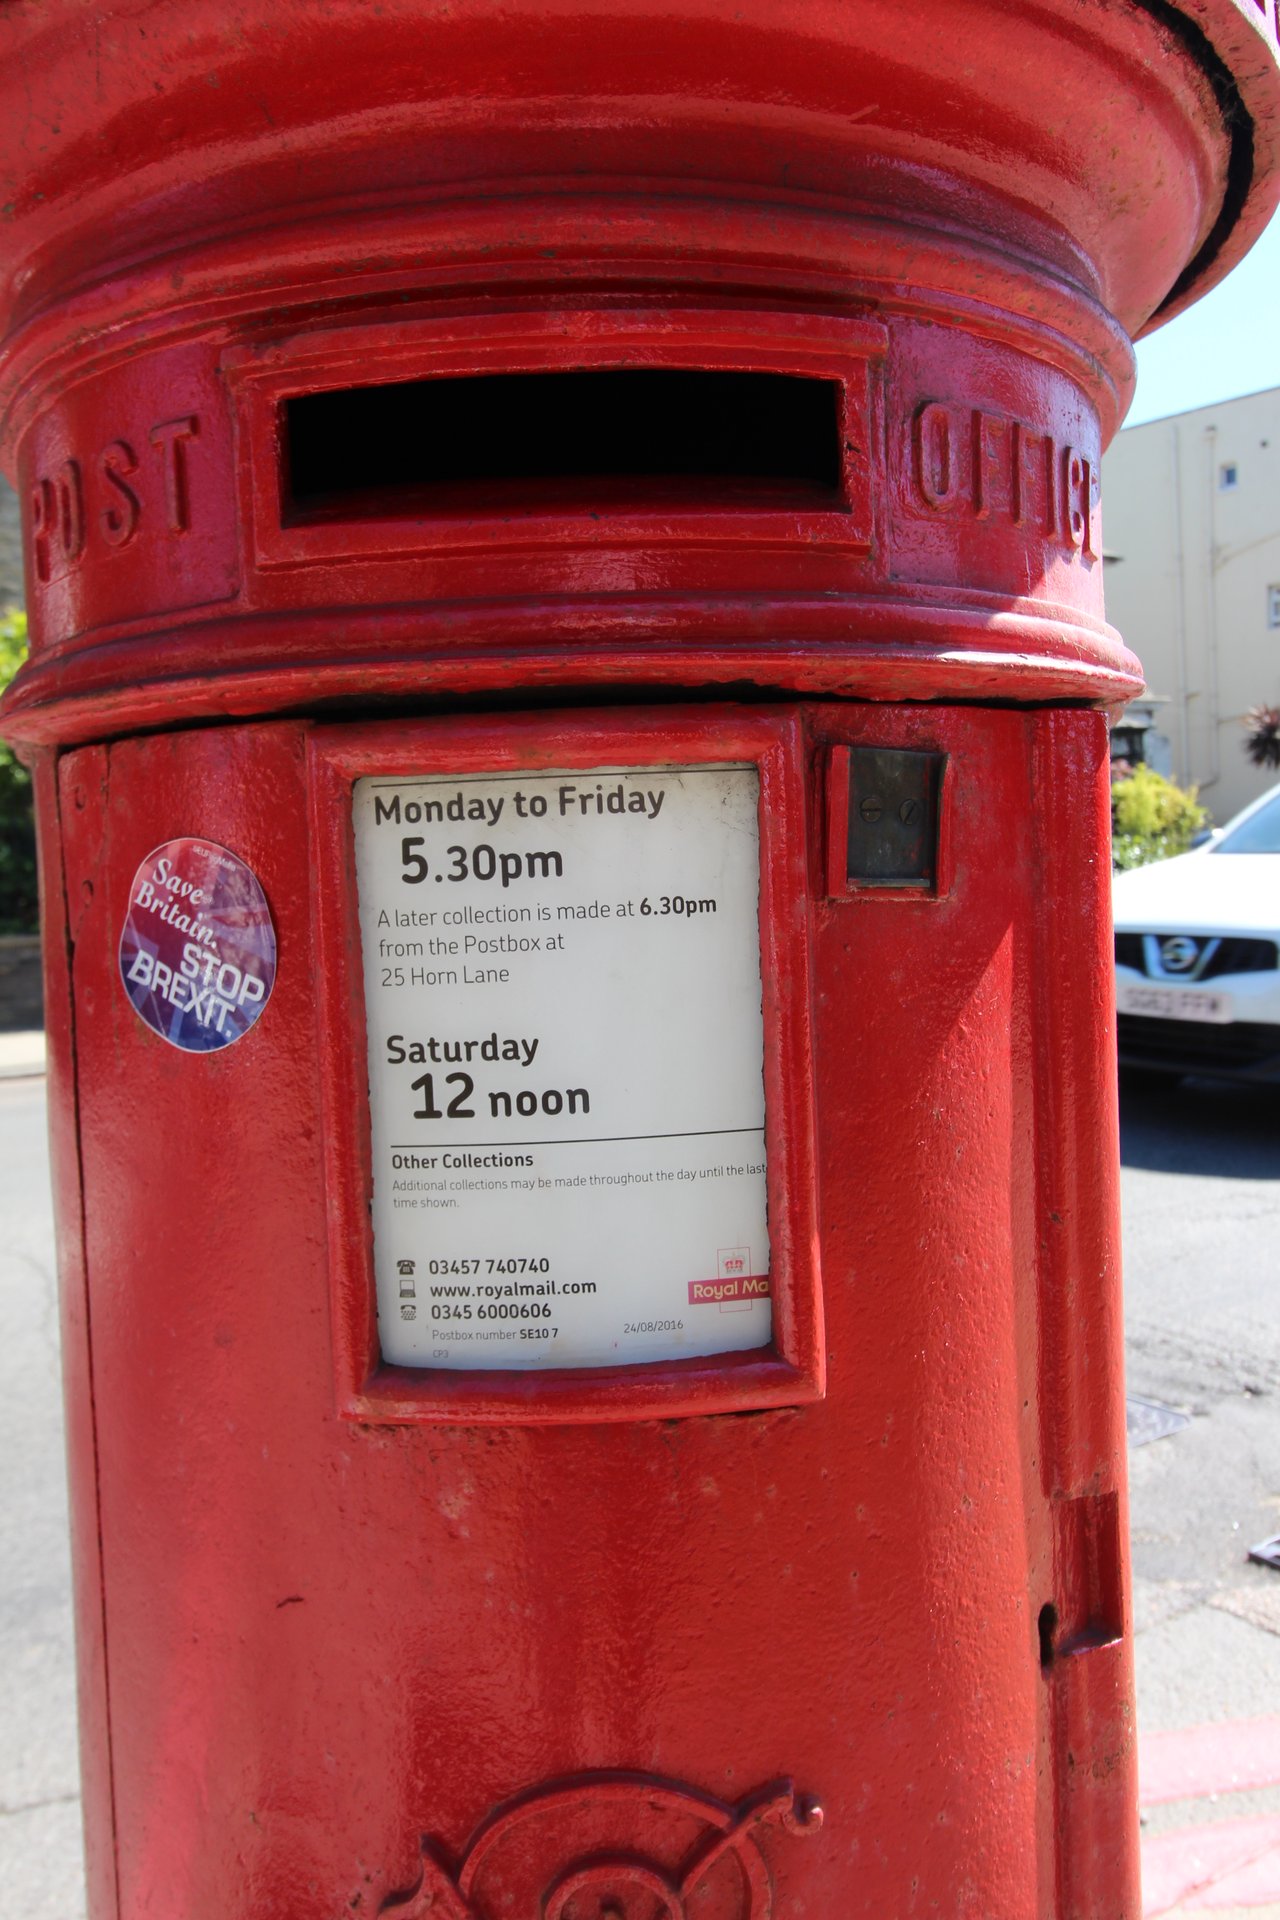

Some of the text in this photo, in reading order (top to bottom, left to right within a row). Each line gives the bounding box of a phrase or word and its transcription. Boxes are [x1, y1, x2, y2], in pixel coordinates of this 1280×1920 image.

[32, 414, 200, 582] POST
[374, 784, 665, 826] Monday to Friday
[400, 836, 563, 887] 5.30pm
[152, 857, 204, 905] Save
[134, 880, 217, 948] Britain.
[377, 895, 717, 928] A later collection is made at 6.30pm
[378, 933, 565, 958] from the Postbox at
[180, 942, 265, 1006] STOP
[381, 964, 510, 987] 25 Horn Lane
[127, 949, 236, 1037] BREXIT.
[387, 1033, 539, 1066] Saturday
[411, 1071, 590, 1119] 12 noon
[392, 1152, 534, 1170] Other Collections
[392, 1179, 447, 1191] Additional
[449, 1178, 508, 1190] collections
[511, 1178, 535, 1191] may
[537, 1176, 551, 1188] be
[555, 1174, 587, 1187] made
[589, 1171, 653, 1187] throughout
[656, 1169, 674, 1182] the
[677, 1168, 697, 1182] day
[699, 1165, 724, 1179] until
[726, 1164, 744, 1177] the
[393, 1197, 460, 1208] time shown.
[429, 1257, 550, 1275] 03457 740740
[430, 1280, 597, 1299] www.royalmail.com
[693, 1281, 738, 1301] Royal
[431, 1303, 551, 1320] 0345 6000606
[432, 1328, 559, 1341] Postbox number SE10 7
[623, 1319, 684, 1334] 24/08/2016
